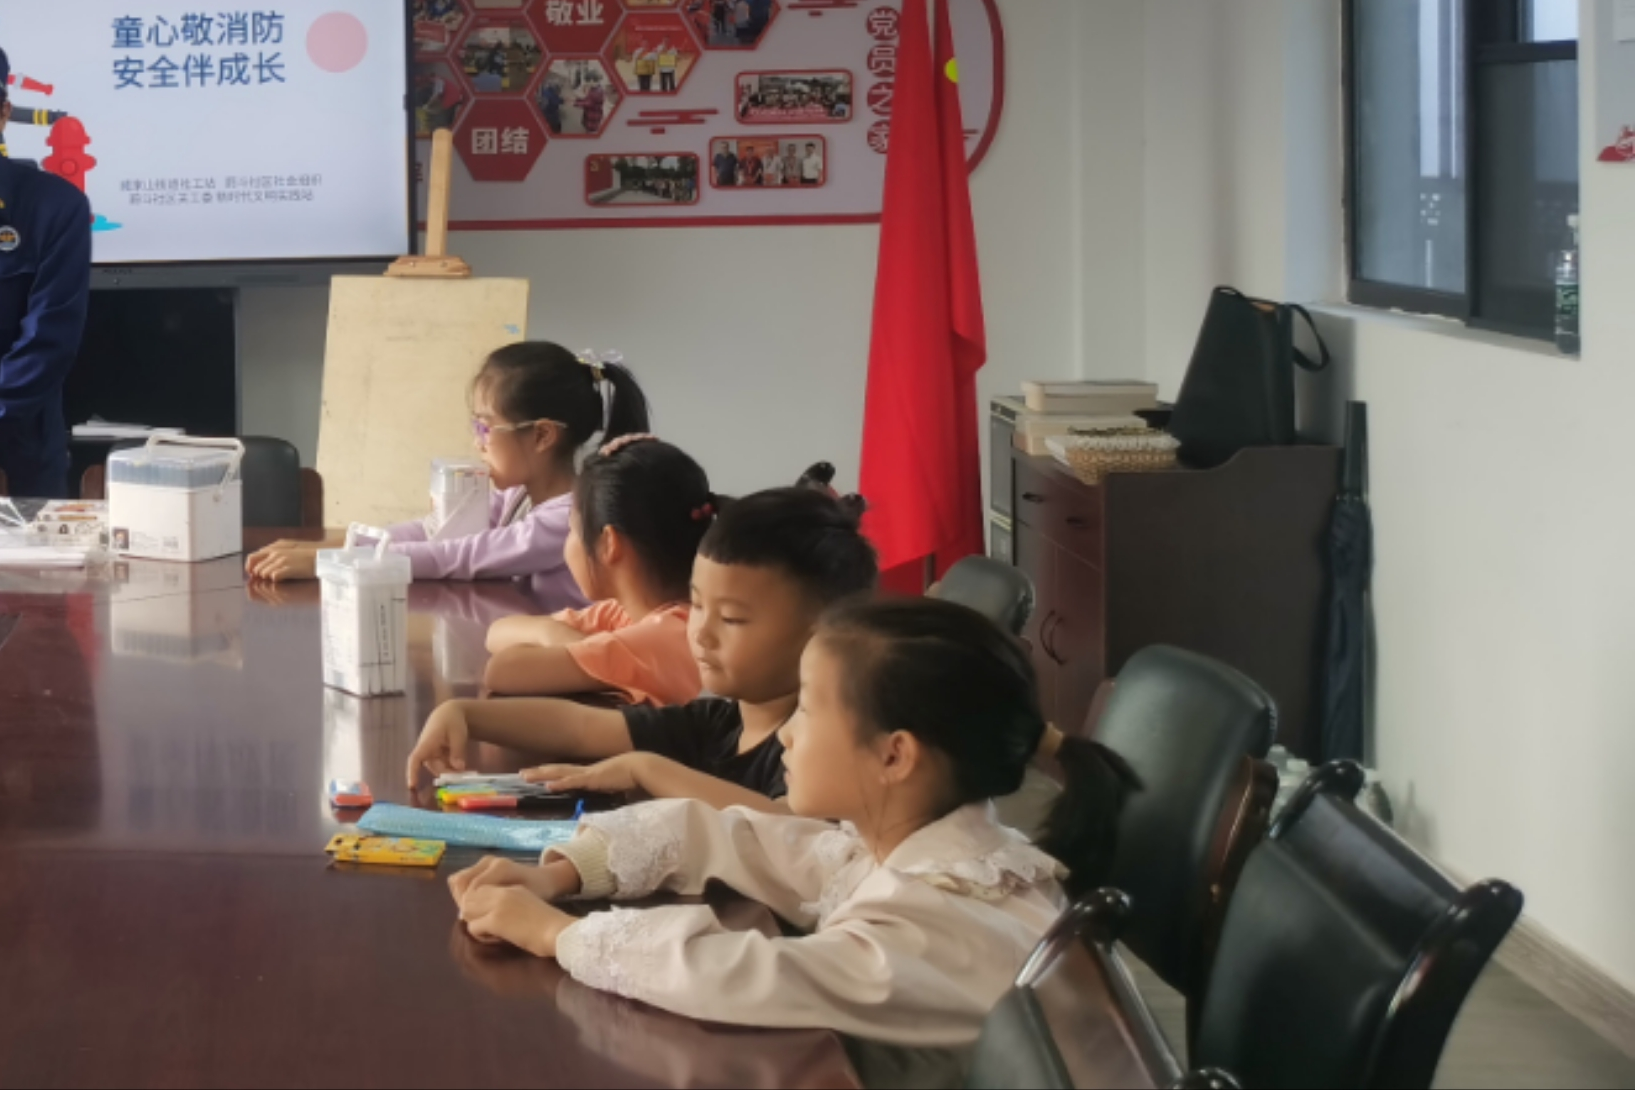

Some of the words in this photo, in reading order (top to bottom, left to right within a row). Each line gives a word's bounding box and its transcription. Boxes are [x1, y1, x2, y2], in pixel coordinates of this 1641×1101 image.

[111, 11, 285, 48] 童心敬消防
[112, 51, 286, 89] 安全伴成长
[471, 126, 530, 155] 团结
